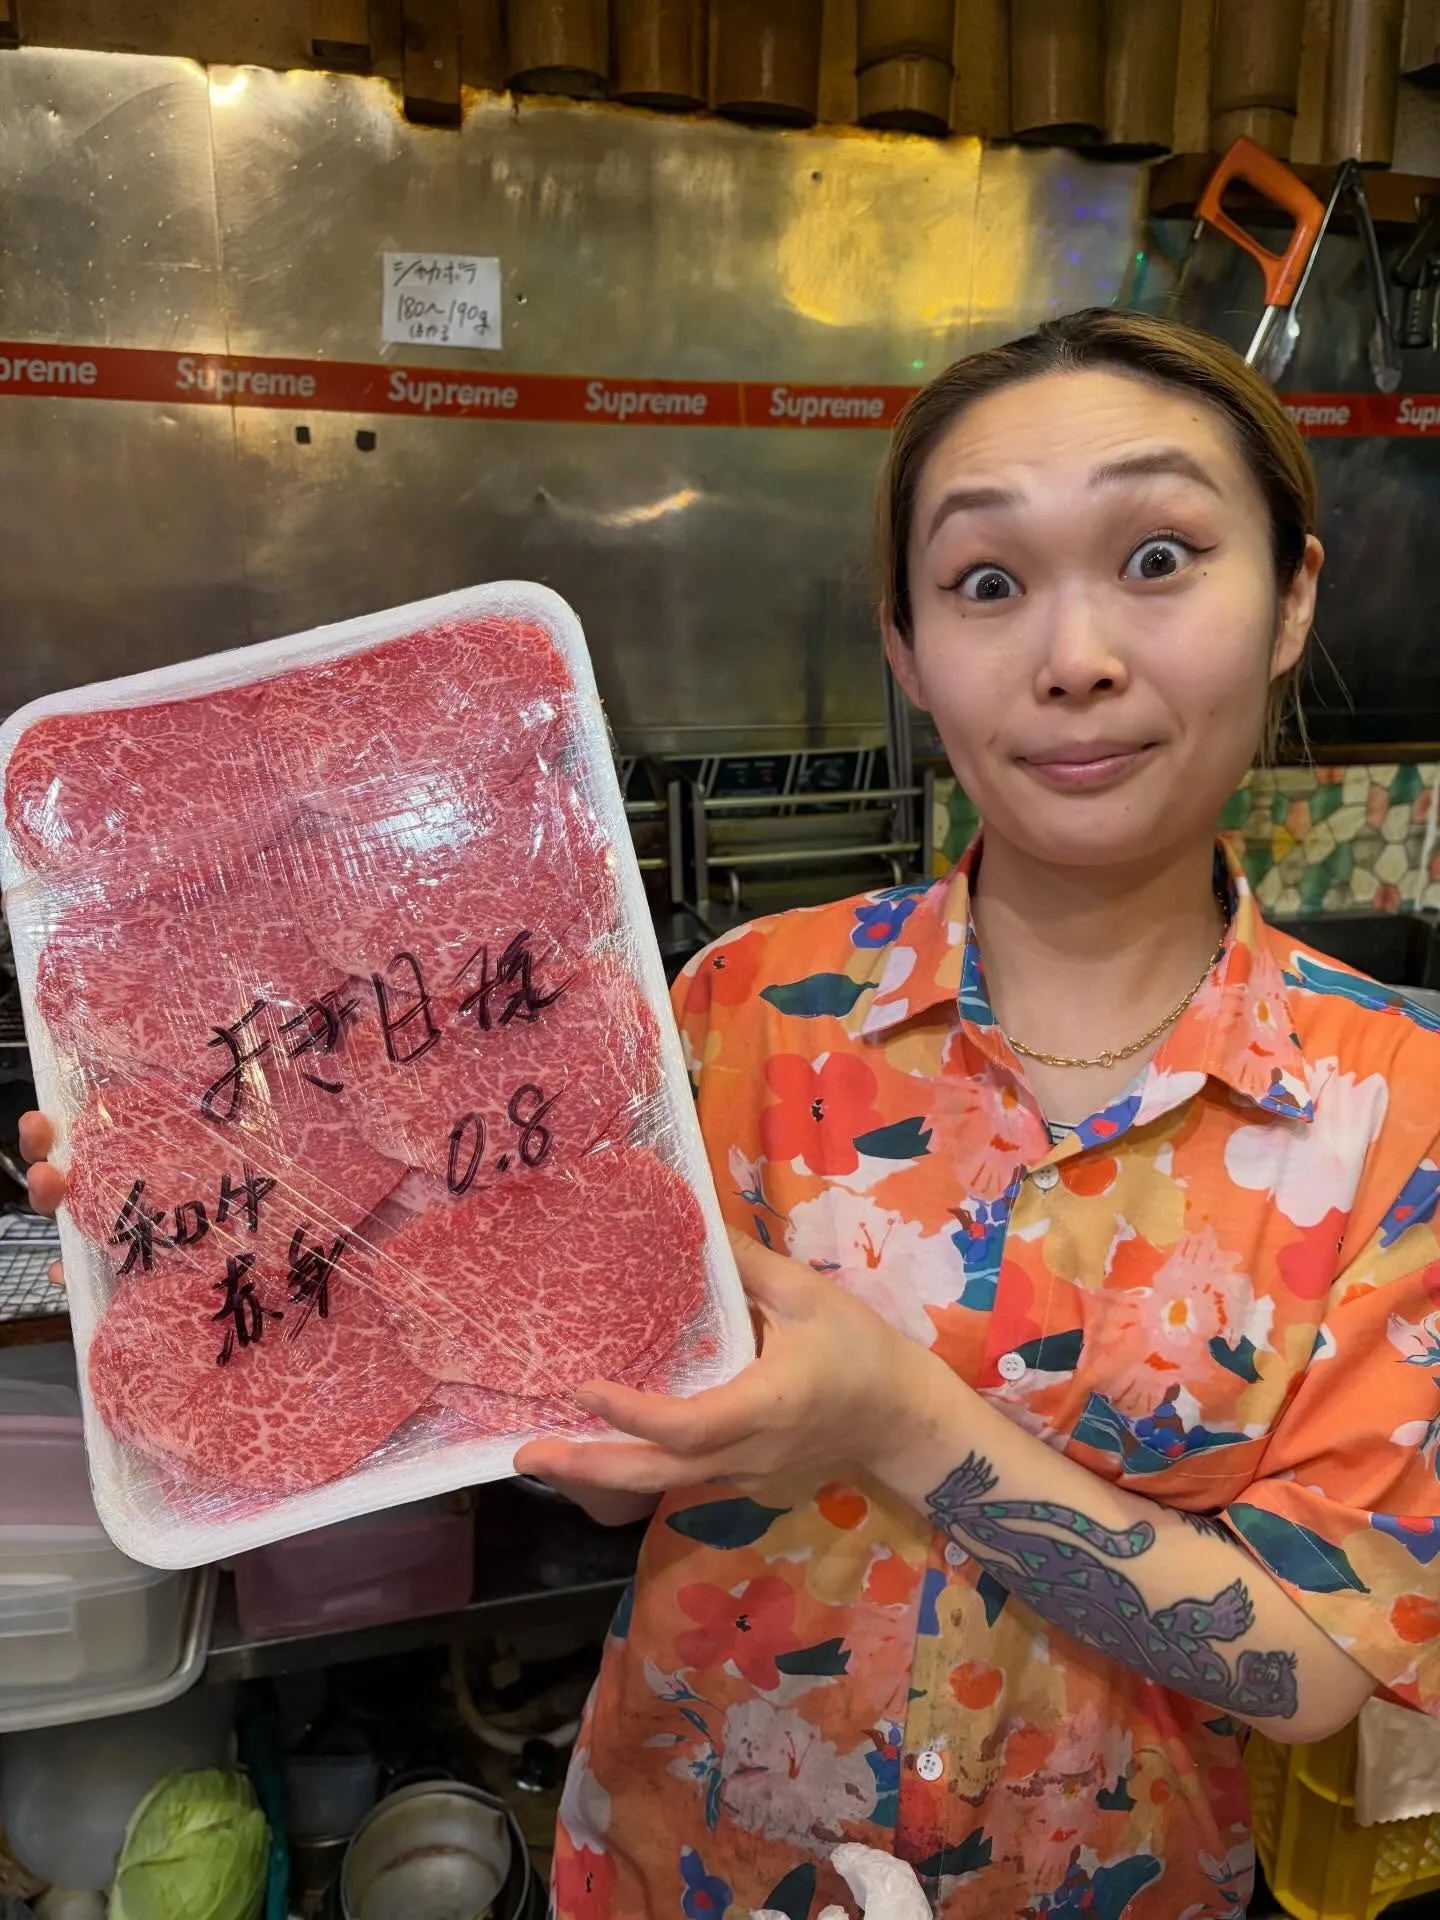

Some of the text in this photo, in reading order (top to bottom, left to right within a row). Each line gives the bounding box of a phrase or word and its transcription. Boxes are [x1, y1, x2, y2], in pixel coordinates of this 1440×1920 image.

[175, 357, 316, 399] Supreme
[387, 371, 519, 411] Supreme
[584, 382, 708, 420] Supreme
[769, 387, 884, 425] Supreme
[446, 1085, 568, 1195] 0.8
[108, 1163, 277, 1275] 和牛
